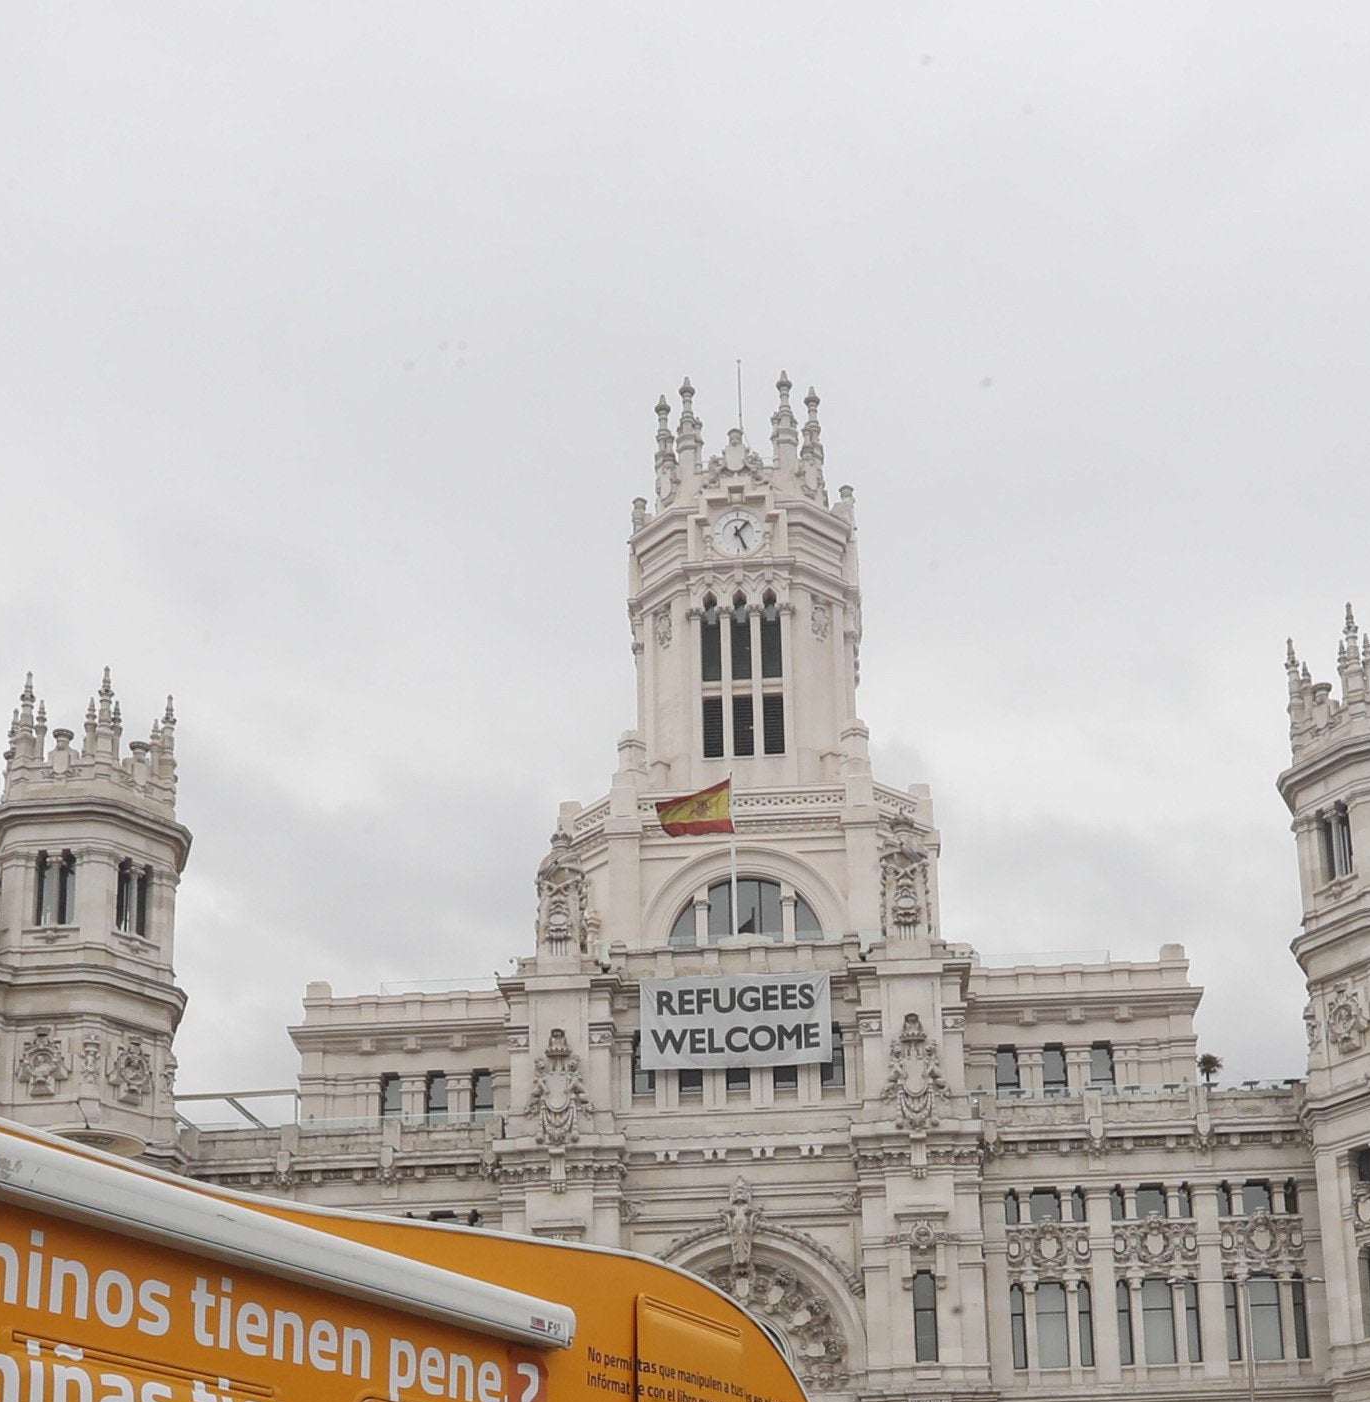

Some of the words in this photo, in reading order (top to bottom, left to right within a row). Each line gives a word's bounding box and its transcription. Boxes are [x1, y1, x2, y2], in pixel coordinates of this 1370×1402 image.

[656, 983, 815, 1016] REFUGEES
[650, 1022, 821, 1055] WELCOME
[191, 1276, 372, 1380] tienen
[587, 1346, 602, 1364] No
[659, 1364, 676, 1379] que
[678, 1370, 722, 1390] manipulen
[724, 1383, 729, 1393] a
[731, 1382, 744, 1397] tus
[647, 1385, 665, 1400] con
[667, 1388, 675, 1402] el
